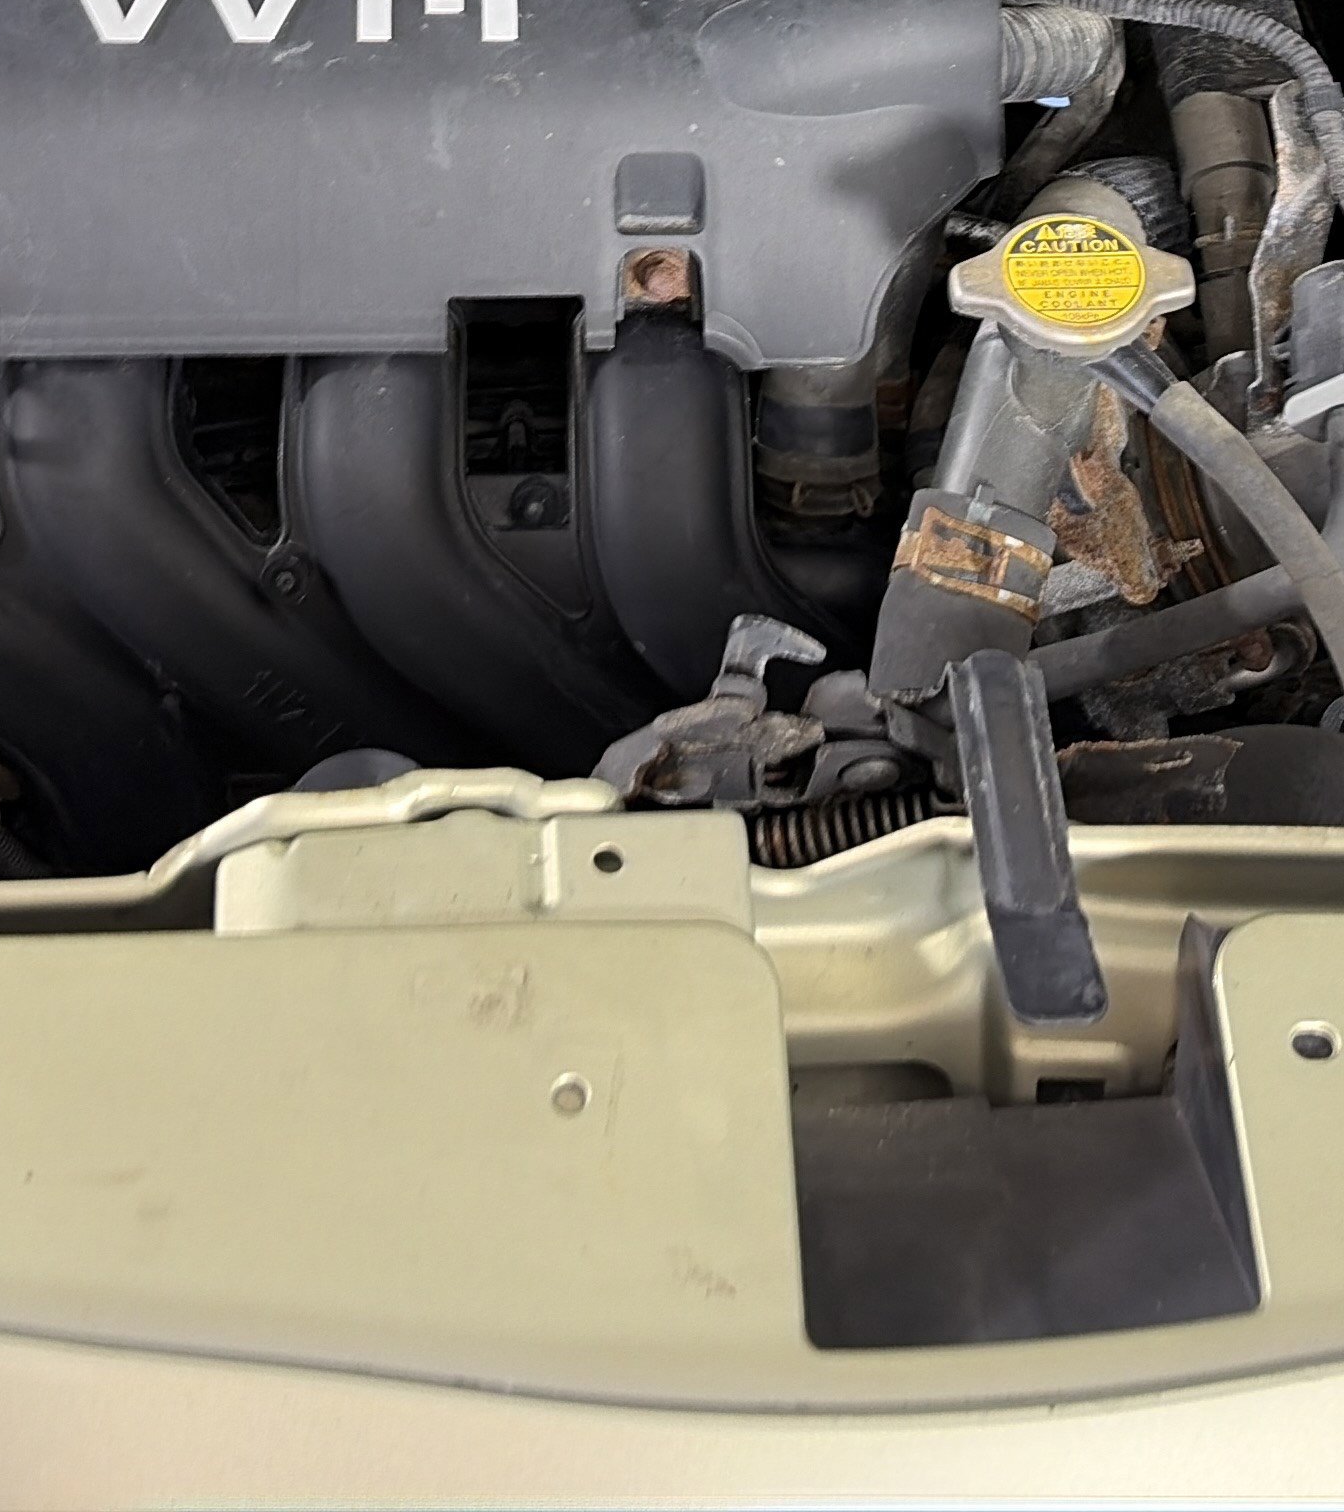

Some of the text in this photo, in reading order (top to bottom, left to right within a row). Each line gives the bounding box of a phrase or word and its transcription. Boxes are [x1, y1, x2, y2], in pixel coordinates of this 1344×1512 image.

[1019, 239, 1119, 253] CAUTION
[1043, 290, 1112, 299] ENGINE
[1039, 299, 1118, 309] COOLANT
